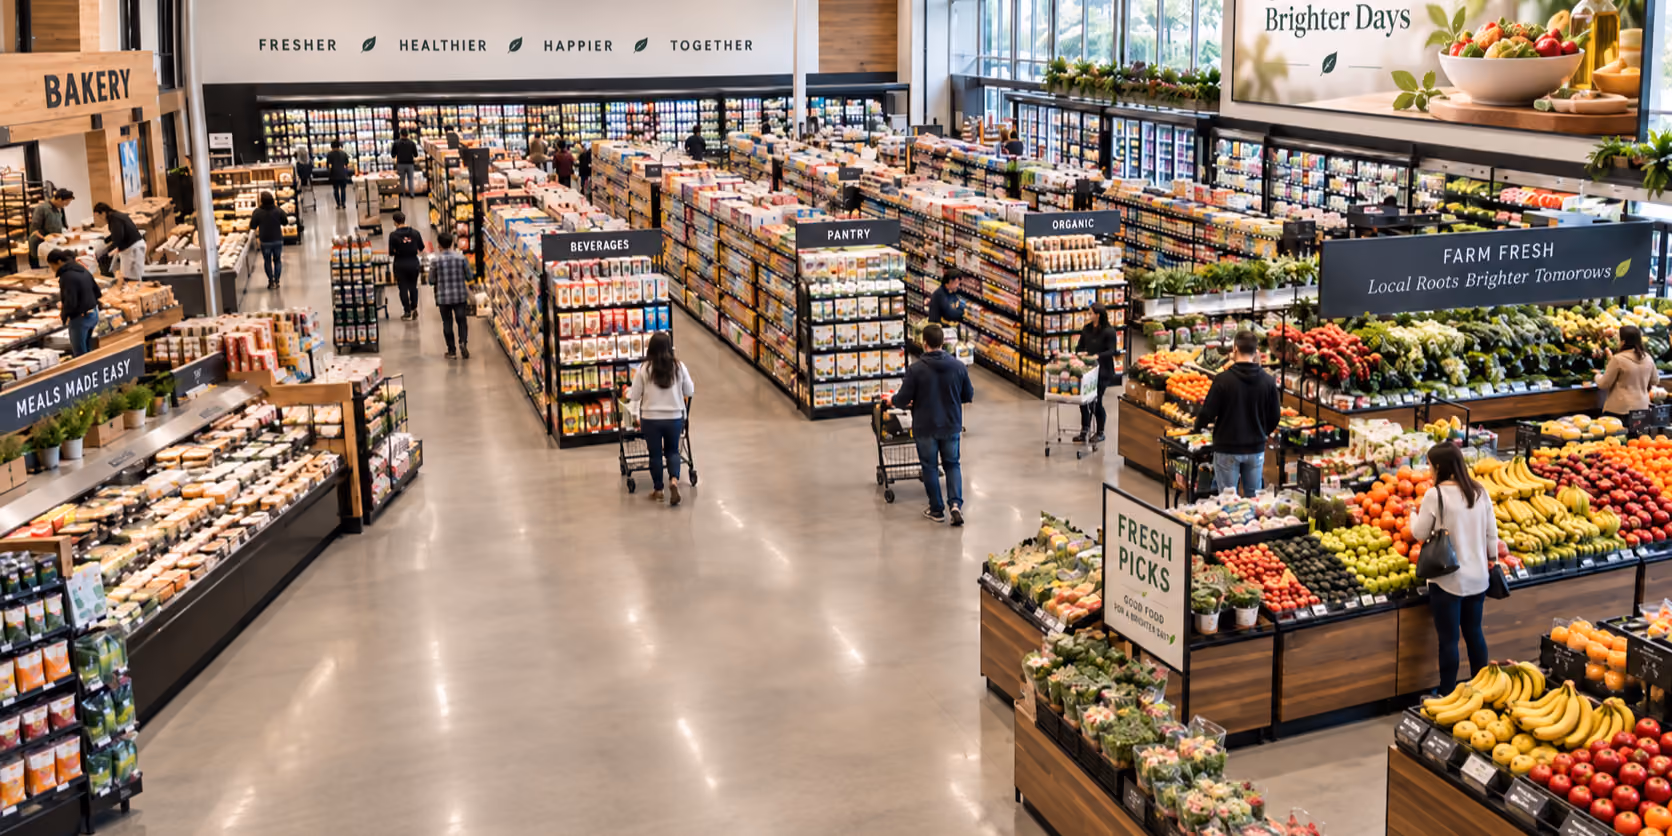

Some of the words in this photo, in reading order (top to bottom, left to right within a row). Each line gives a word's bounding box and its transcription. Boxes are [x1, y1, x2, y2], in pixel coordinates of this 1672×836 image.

[1265, 4, 1350, 38] Brighter
[1356, 3, 1411, 37] Days
[258, 38, 337, 52] FRESHER
[399, 39, 487, 52] HEALTHIER
[544, 39, 613, 52] HAPPIER
[670, 39, 753, 52] TOGETHER
[44, 68, 130, 109] BAKERY
[828, 228, 870, 241] PANTRY
[1052, 218, 1094, 230] ORGANIC
[570, 239, 630, 253] BEVERAGES
[1443, 246, 1490, 265] FARM
[1499, 242, 1555, 261] FRESH
[1367, 276, 1411, 295] Local
[1416, 274, 1459, 290] Roots
[1465, 270, 1529, 290] Brighter
[1535, 265, 1612, 283] Tomorows
[16, 386, 61, 419] MEALS
[66, 372, 99, 399] MADE
[103, 358, 131, 384] EASY
[1118, 512, 1172, 562] FRESH
[1119, 545, 1170, 593] PICKS
[1123, 594, 1143, 613] GOOD
[1145, 606, 1164, 625] FOOD
